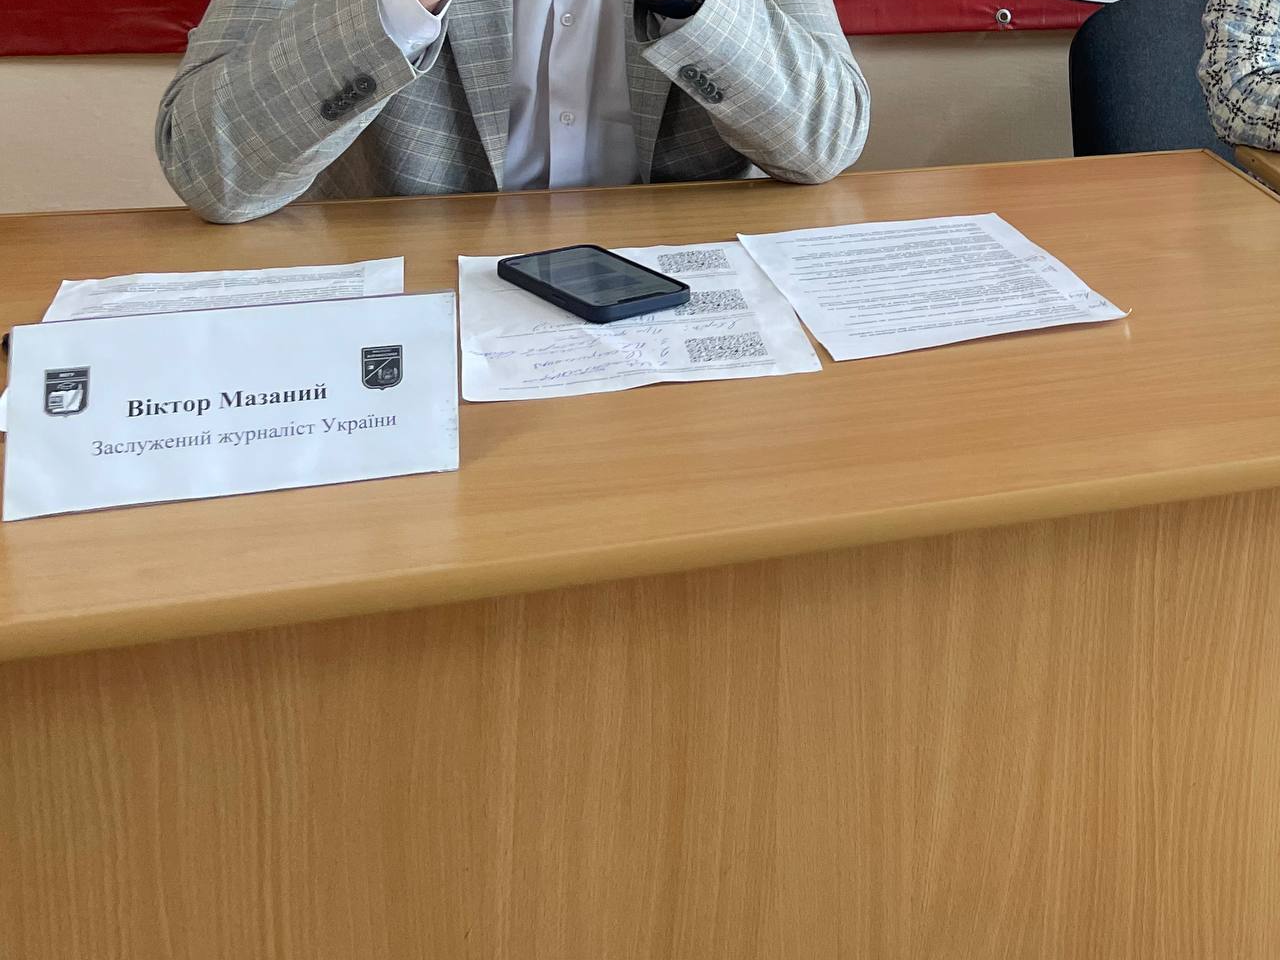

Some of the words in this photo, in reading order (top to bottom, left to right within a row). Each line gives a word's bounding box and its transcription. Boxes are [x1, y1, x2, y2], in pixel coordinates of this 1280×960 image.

[126, 398, 211, 417] Віктор
[219, 383, 327, 409] Мазаний
[92, 431, 211, 456] Заслужений
[219, 421, 316, 446] журналіст
[322, 414, 397, 434] України
